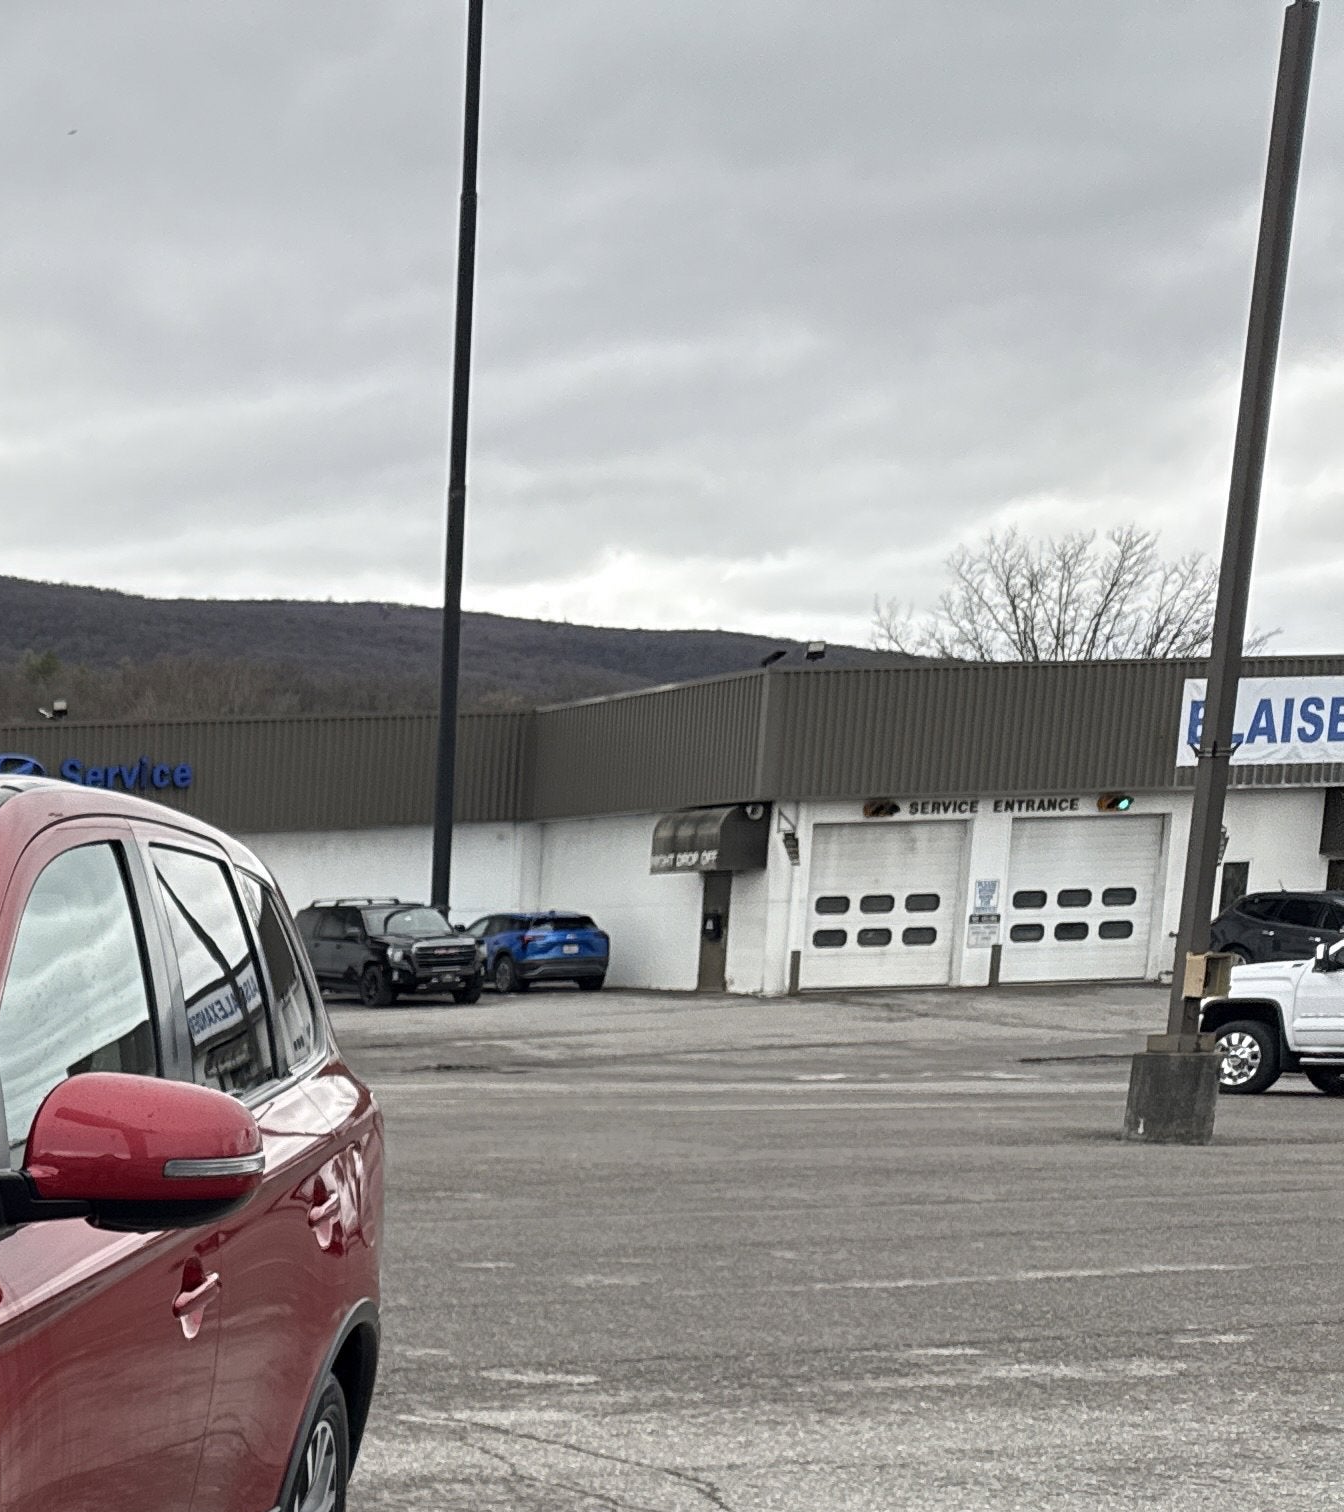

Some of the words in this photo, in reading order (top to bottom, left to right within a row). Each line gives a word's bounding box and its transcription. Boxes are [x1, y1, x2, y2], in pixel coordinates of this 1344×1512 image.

[60, 755, 192, 789] Service
[909, 801, 979, 815] SERVICE
[993, 798, 1079, 813] ENTRANCE
